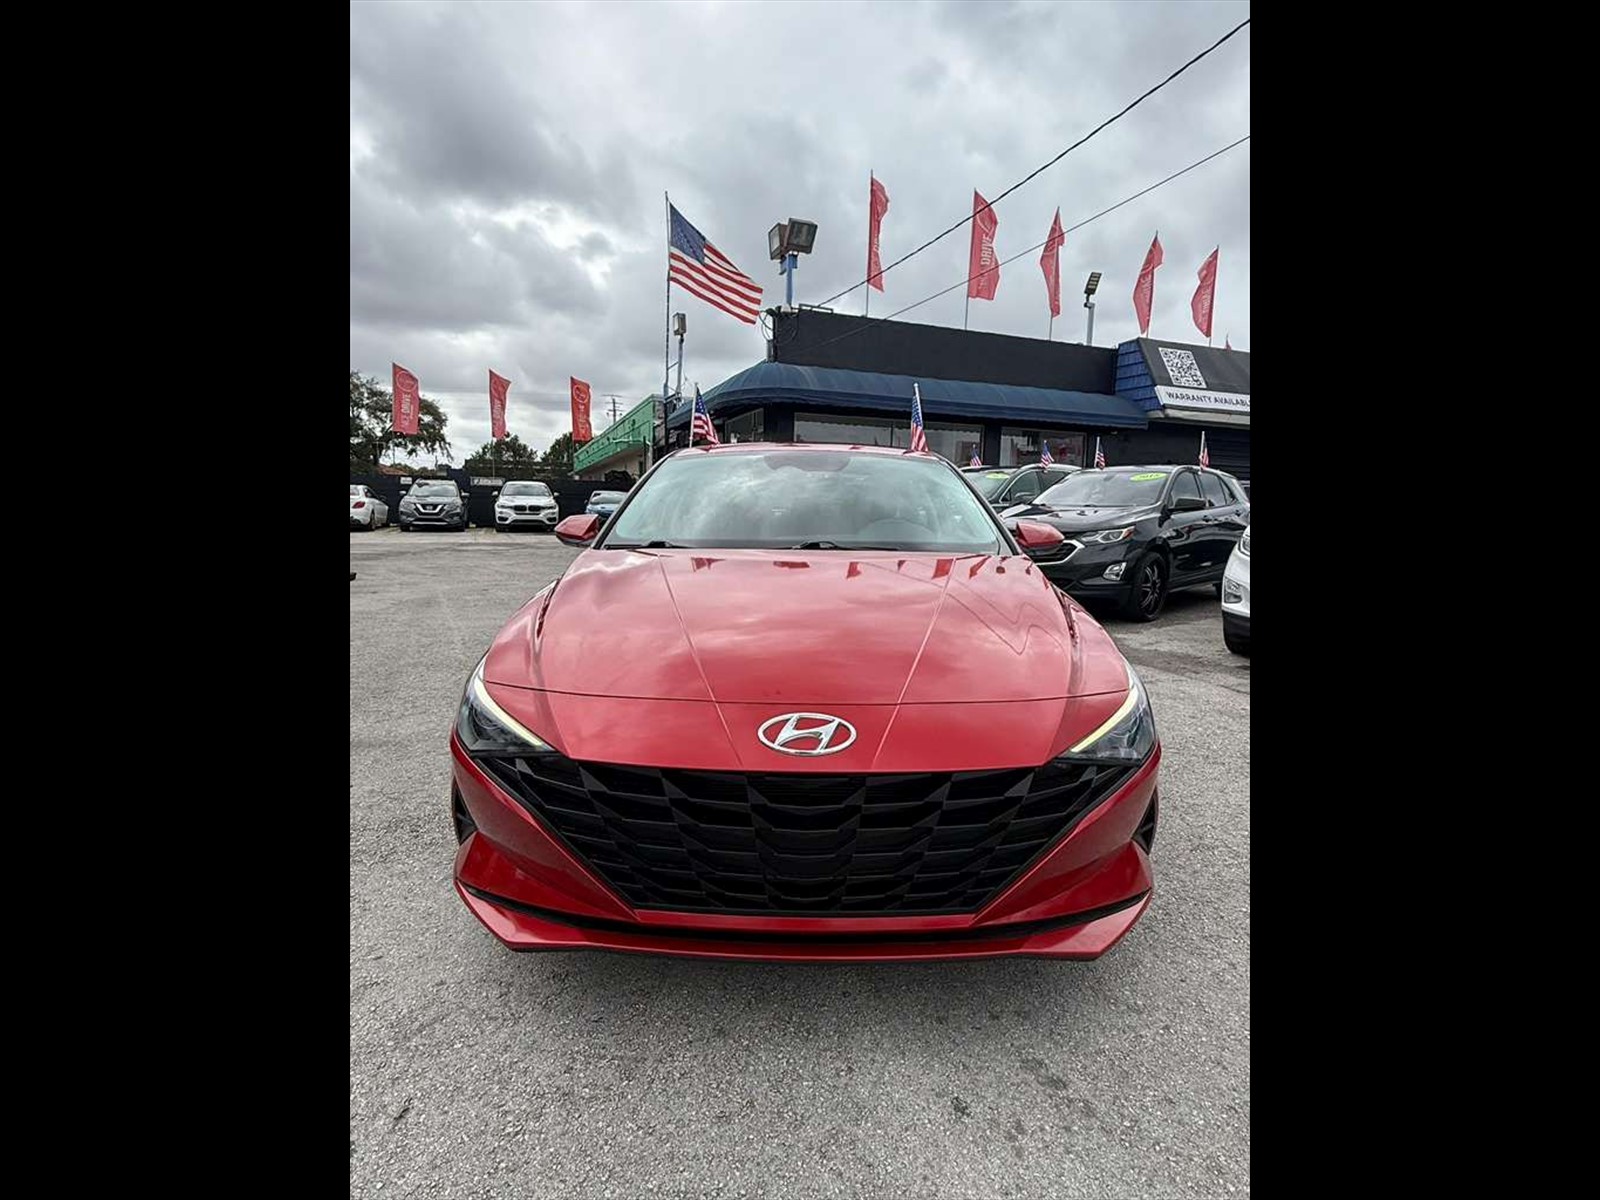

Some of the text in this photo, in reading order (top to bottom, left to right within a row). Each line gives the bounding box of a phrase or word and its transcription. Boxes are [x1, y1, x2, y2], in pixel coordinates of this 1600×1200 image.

[980, 234, 992, 265] DRIVE
[1166, 391, 1250, 407] WARRANTY AVAILABL
